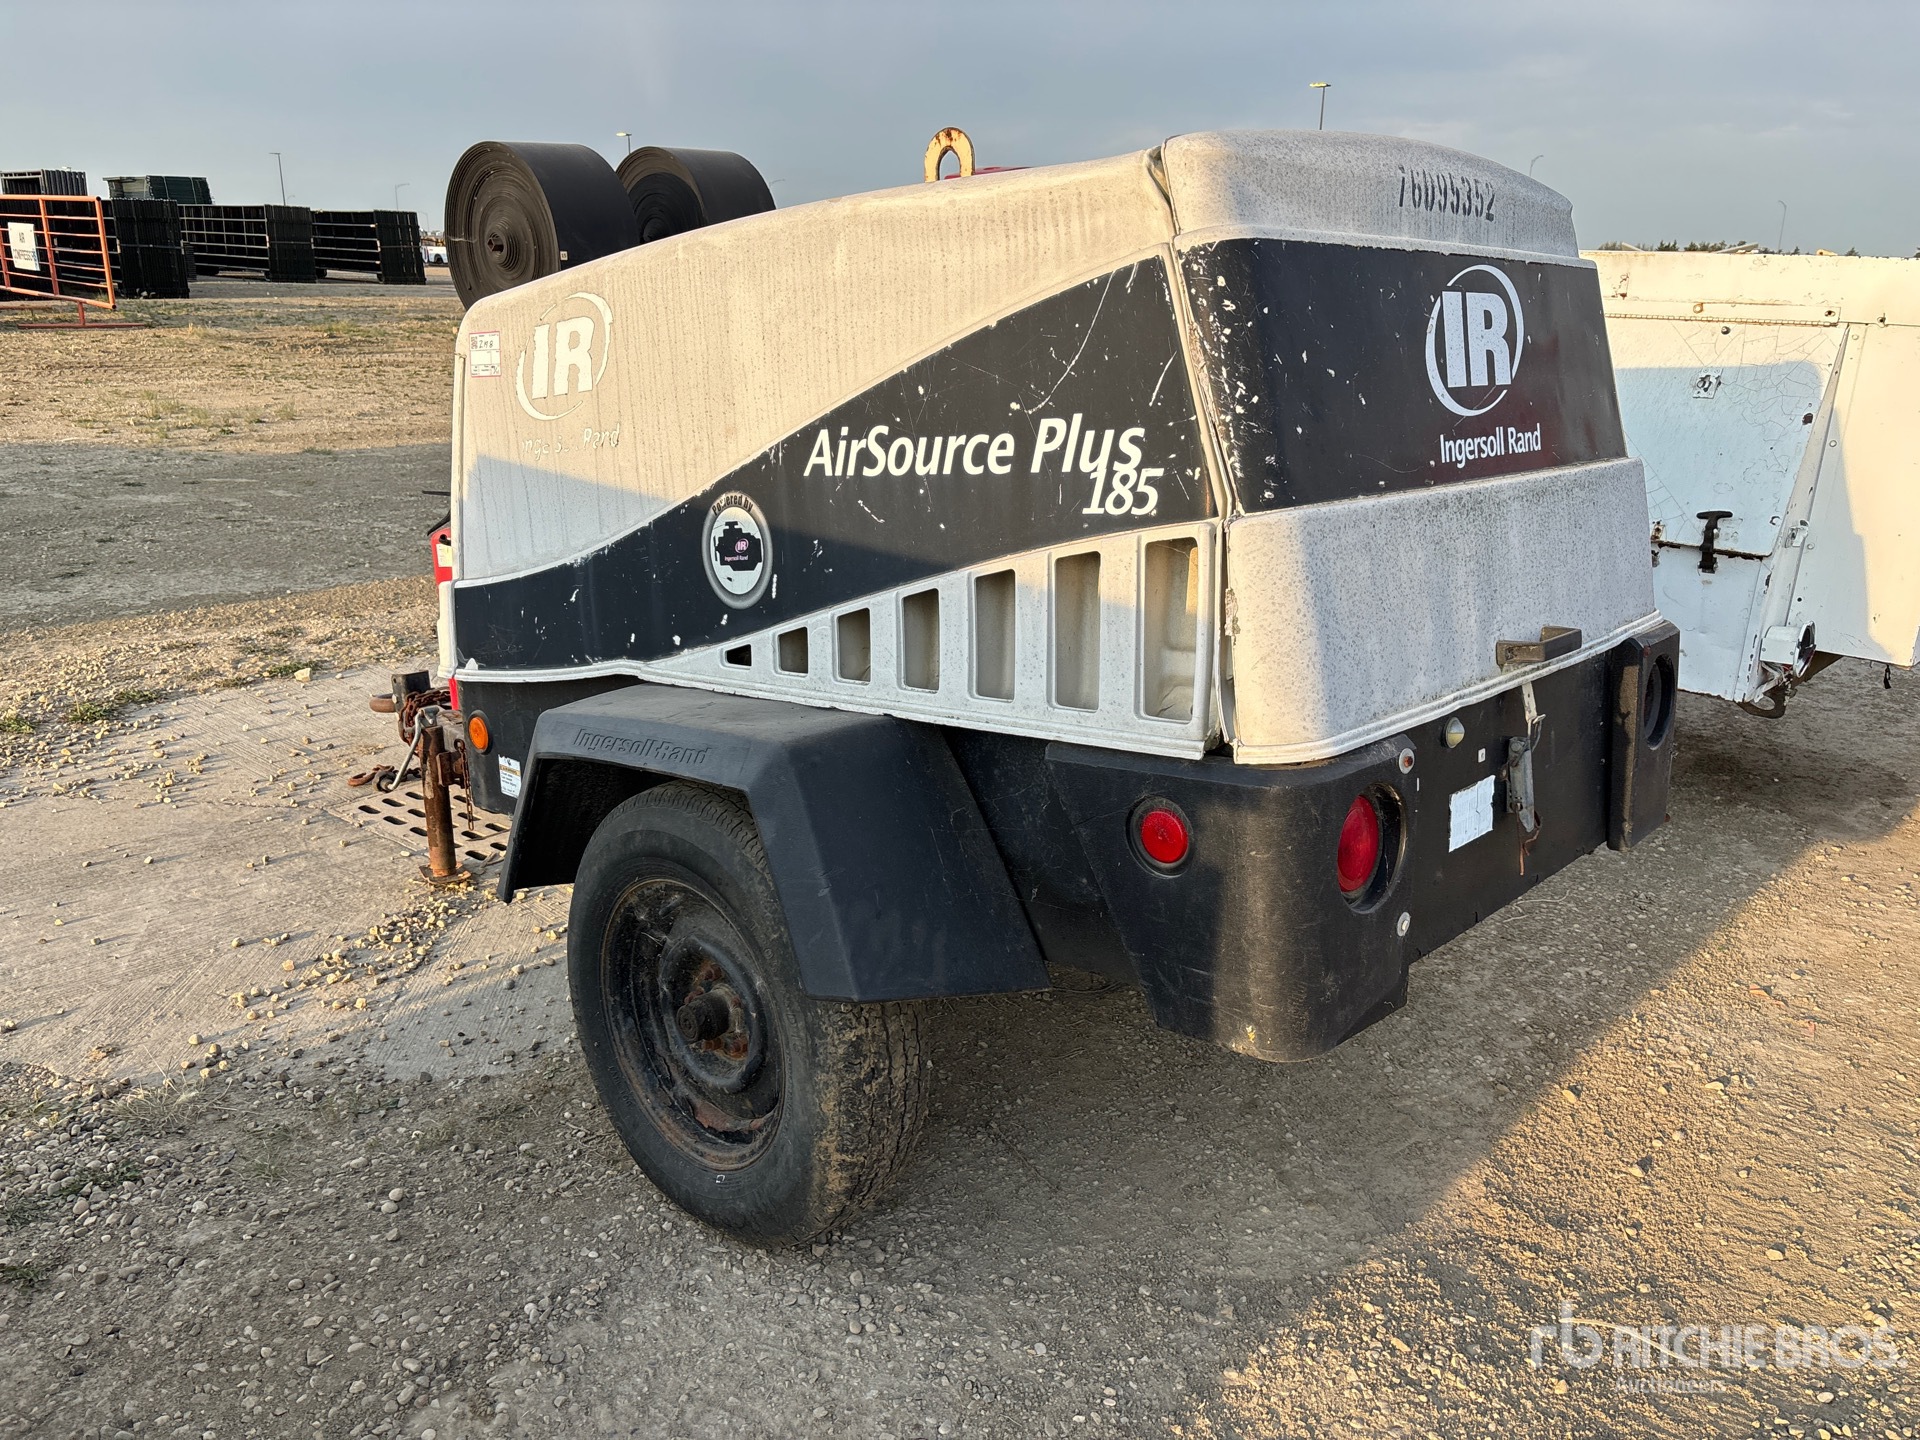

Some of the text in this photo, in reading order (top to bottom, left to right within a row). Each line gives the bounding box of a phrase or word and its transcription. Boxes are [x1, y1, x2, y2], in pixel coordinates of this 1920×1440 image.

[532, 316, 595, 399] IR
[1442, 291, 1511, 387] IR
[803, 413, 1145, 477] AirSource Plus
[1440, 422, 1542, 469] Ingersoll Rand
[744, 497, 754, 512] by
[1082, 467, 1164, 516] 185
